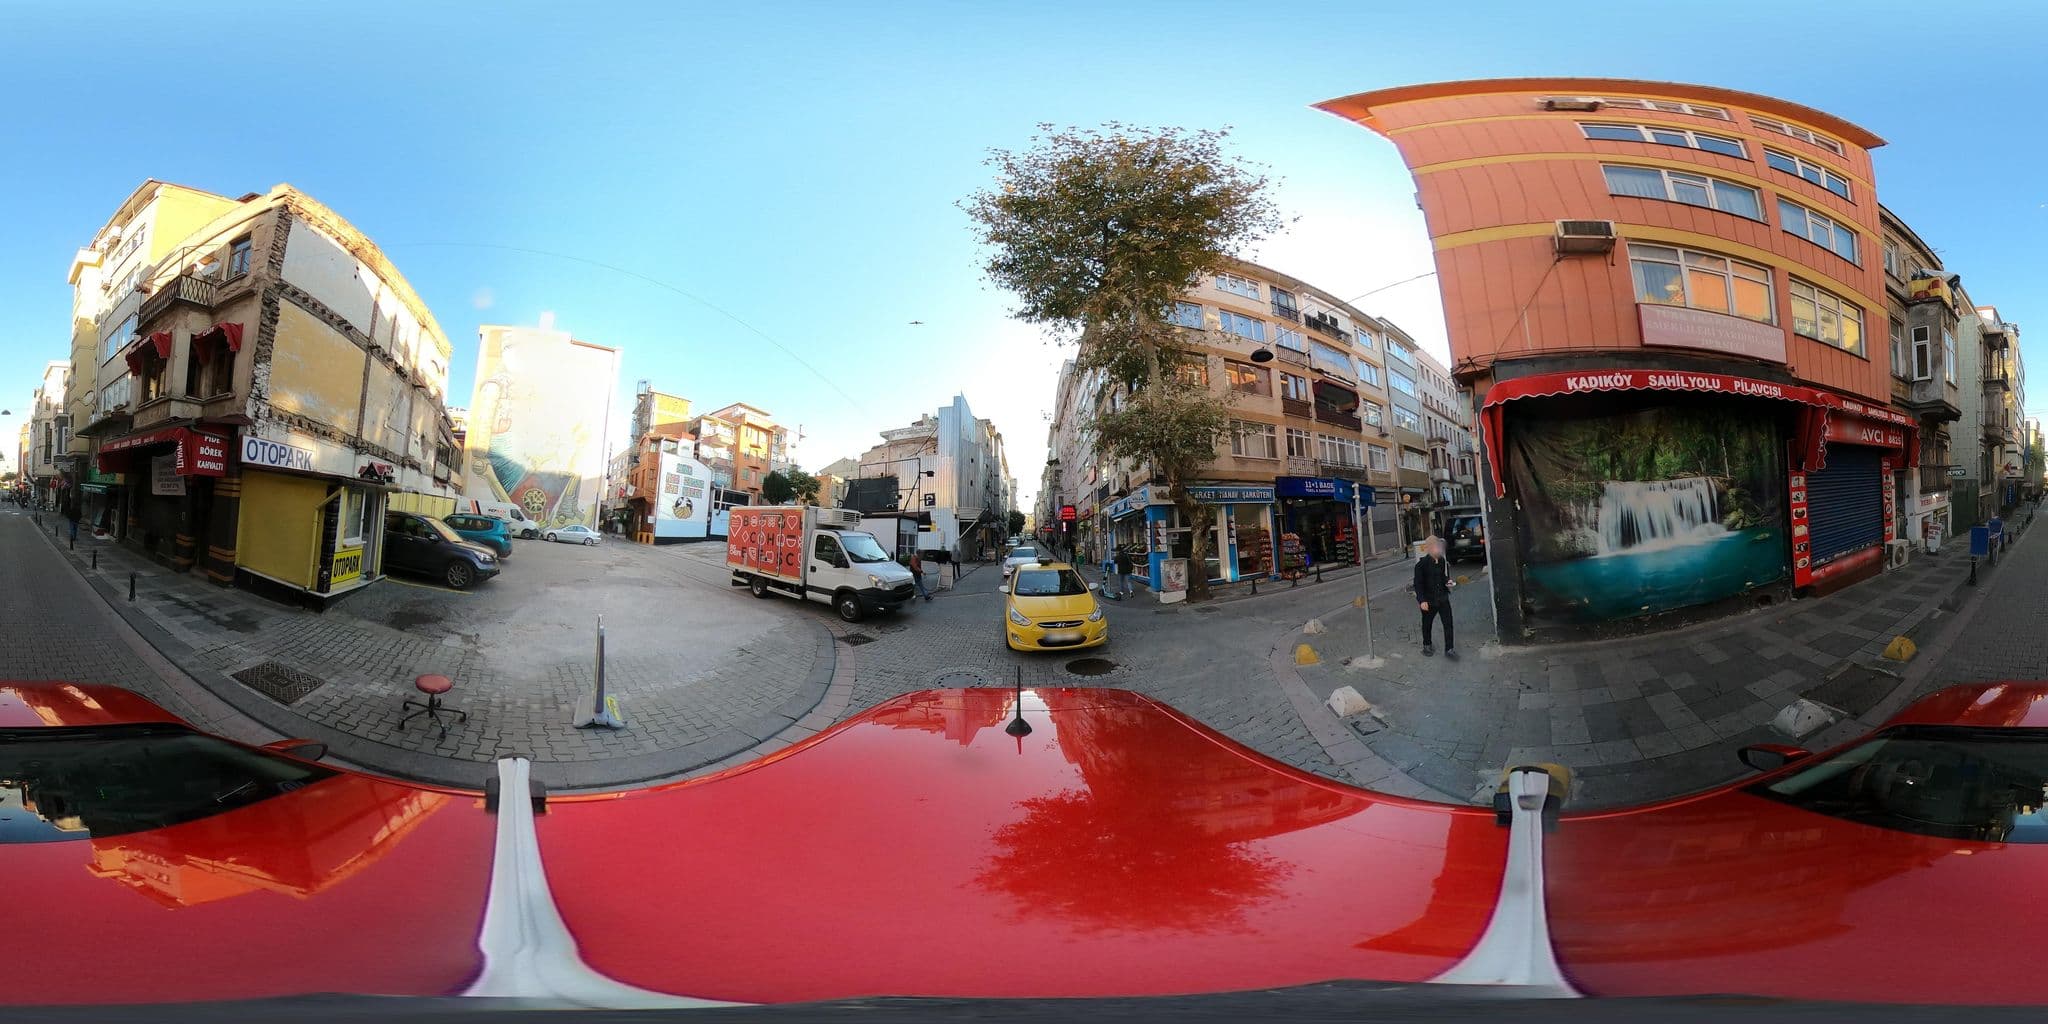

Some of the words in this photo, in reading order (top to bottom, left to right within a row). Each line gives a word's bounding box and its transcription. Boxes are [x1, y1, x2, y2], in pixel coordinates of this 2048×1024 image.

[1566, 372, 1633, 390] KADIKÖY
[1861, 427, 1884, 444] AVCI
[199, 446, 223, 458] BÖREK
[246, 439, 313, 471] OTOPARK
[197, 460, 224, 471] KAHVALTI
[333, 554, 361, 578] OTOPARK
